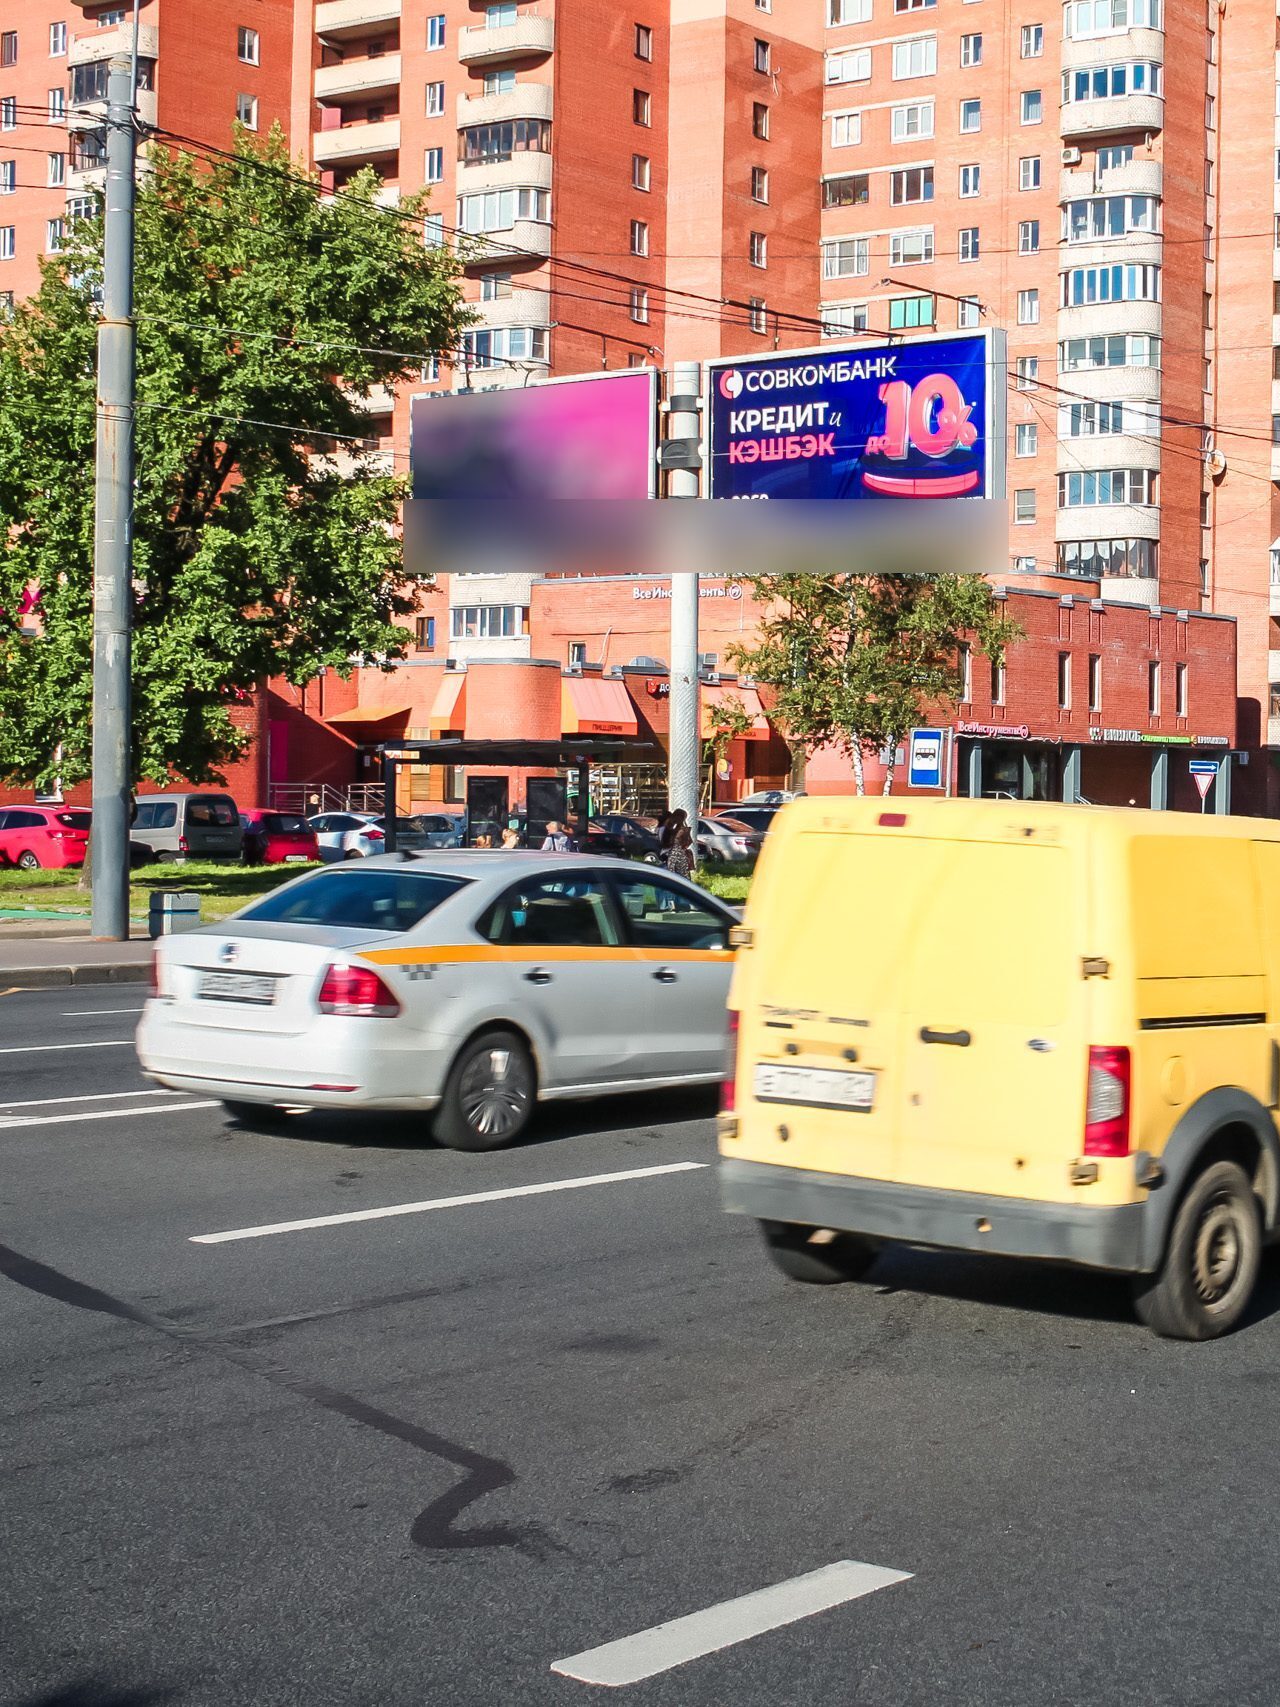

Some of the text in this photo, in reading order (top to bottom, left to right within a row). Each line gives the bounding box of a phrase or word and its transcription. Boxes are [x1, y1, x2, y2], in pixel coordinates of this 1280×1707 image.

[745, 356, 898, 393] СОВКОМБАНК
[730, 402, 829, 434] КРЕДИТ
[729, 432, 835, 464] КЭШБЭК
[633, 586, 727, 599] ВсеИнсенты
